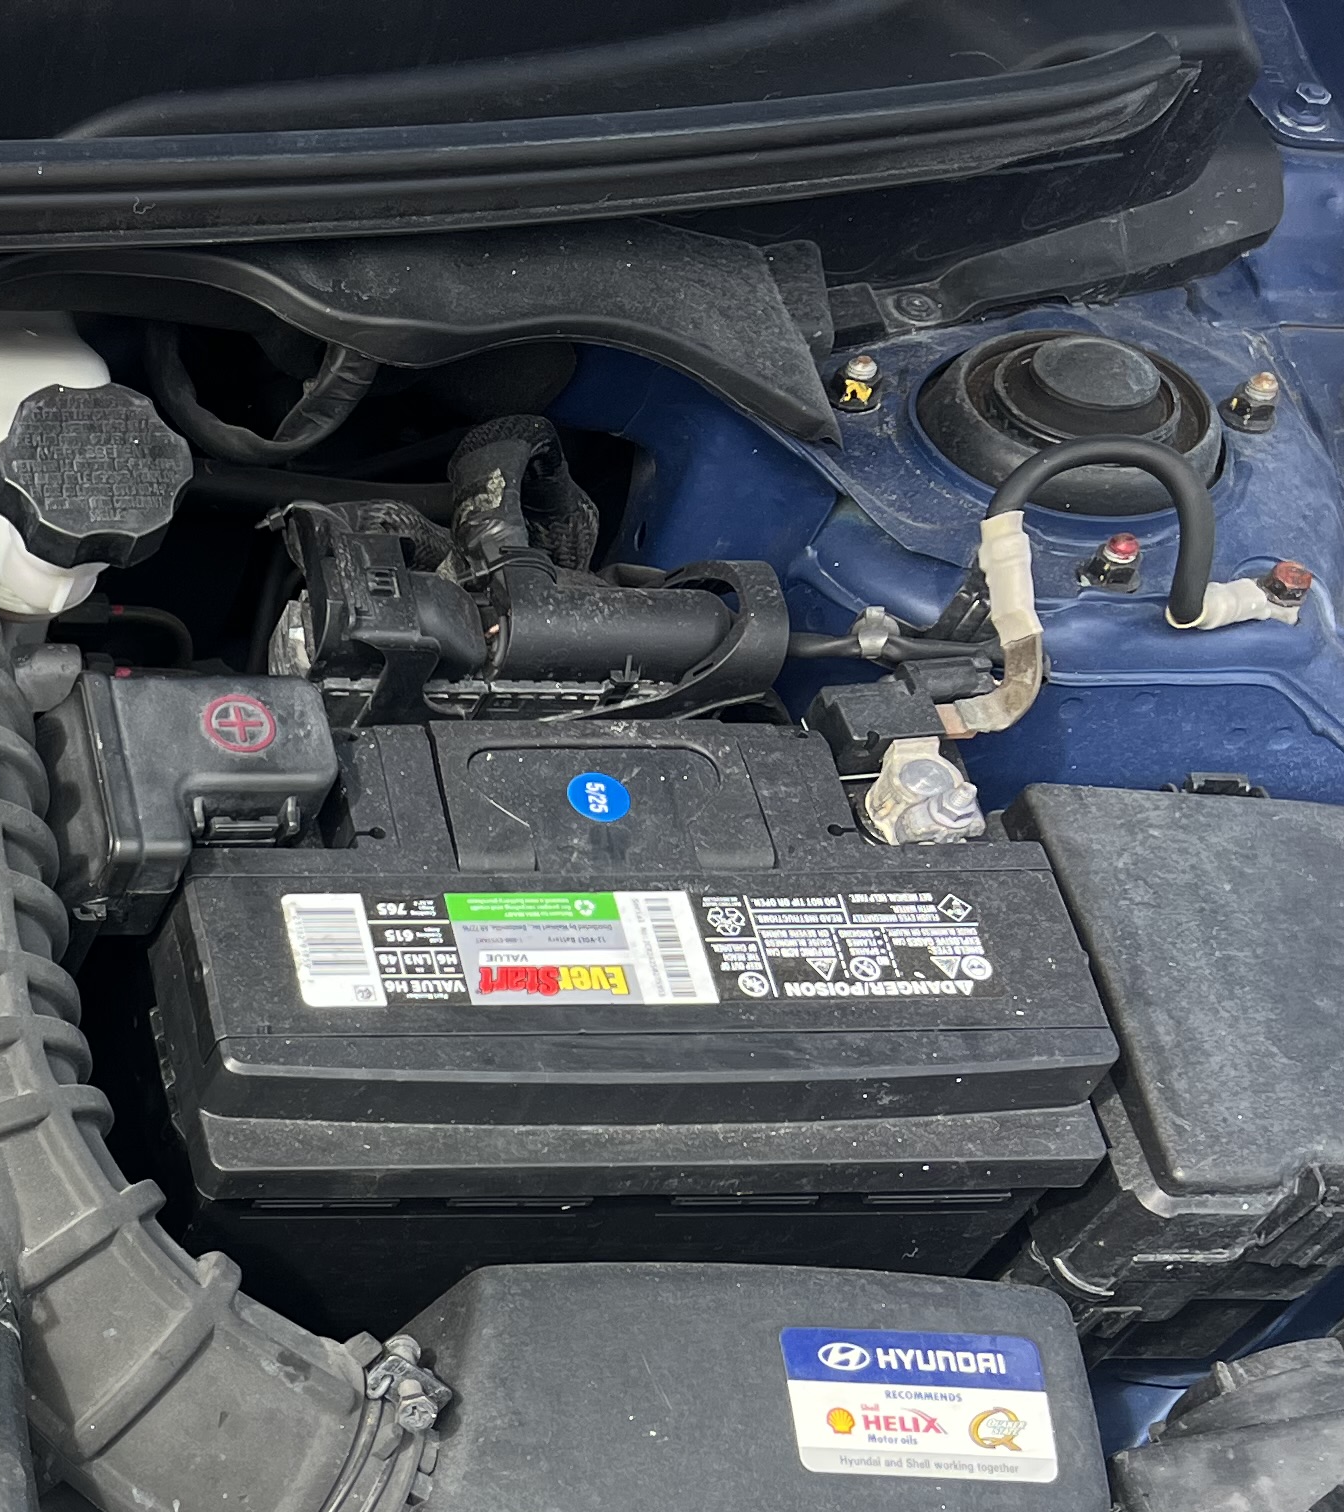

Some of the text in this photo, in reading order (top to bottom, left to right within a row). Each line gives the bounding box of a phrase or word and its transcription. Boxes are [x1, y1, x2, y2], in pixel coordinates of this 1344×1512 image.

[584, 782, 609, 813] 5/25
[806, 898, 823, 906] NOT
[824, 898, 837, 906] DO
[377, 903, 407, 915] 765
[384, 929, 414, 941] 615
[378, 954, 397, 965] 48
[403, 953, 432, 965] LN3
[436, 953, 457, 965] H6
[486, 954, 528, 962] VALUE
[384, 980, 466, 992] VALUE H6
[478, 965, 630, 996] EverStart
[784, 981, 957, 996] DANGER/POISON
[877, 1348, 1006, 1374] HYUNDAI
[884, 1389, 963, 1402] RECOMMENDS
[862, 1411, 945, 1434] HELIX
[867, 1434, 918, 1445] Motor oils
[839, 1455, 1019, 1474] Hyundai and Shell working together
